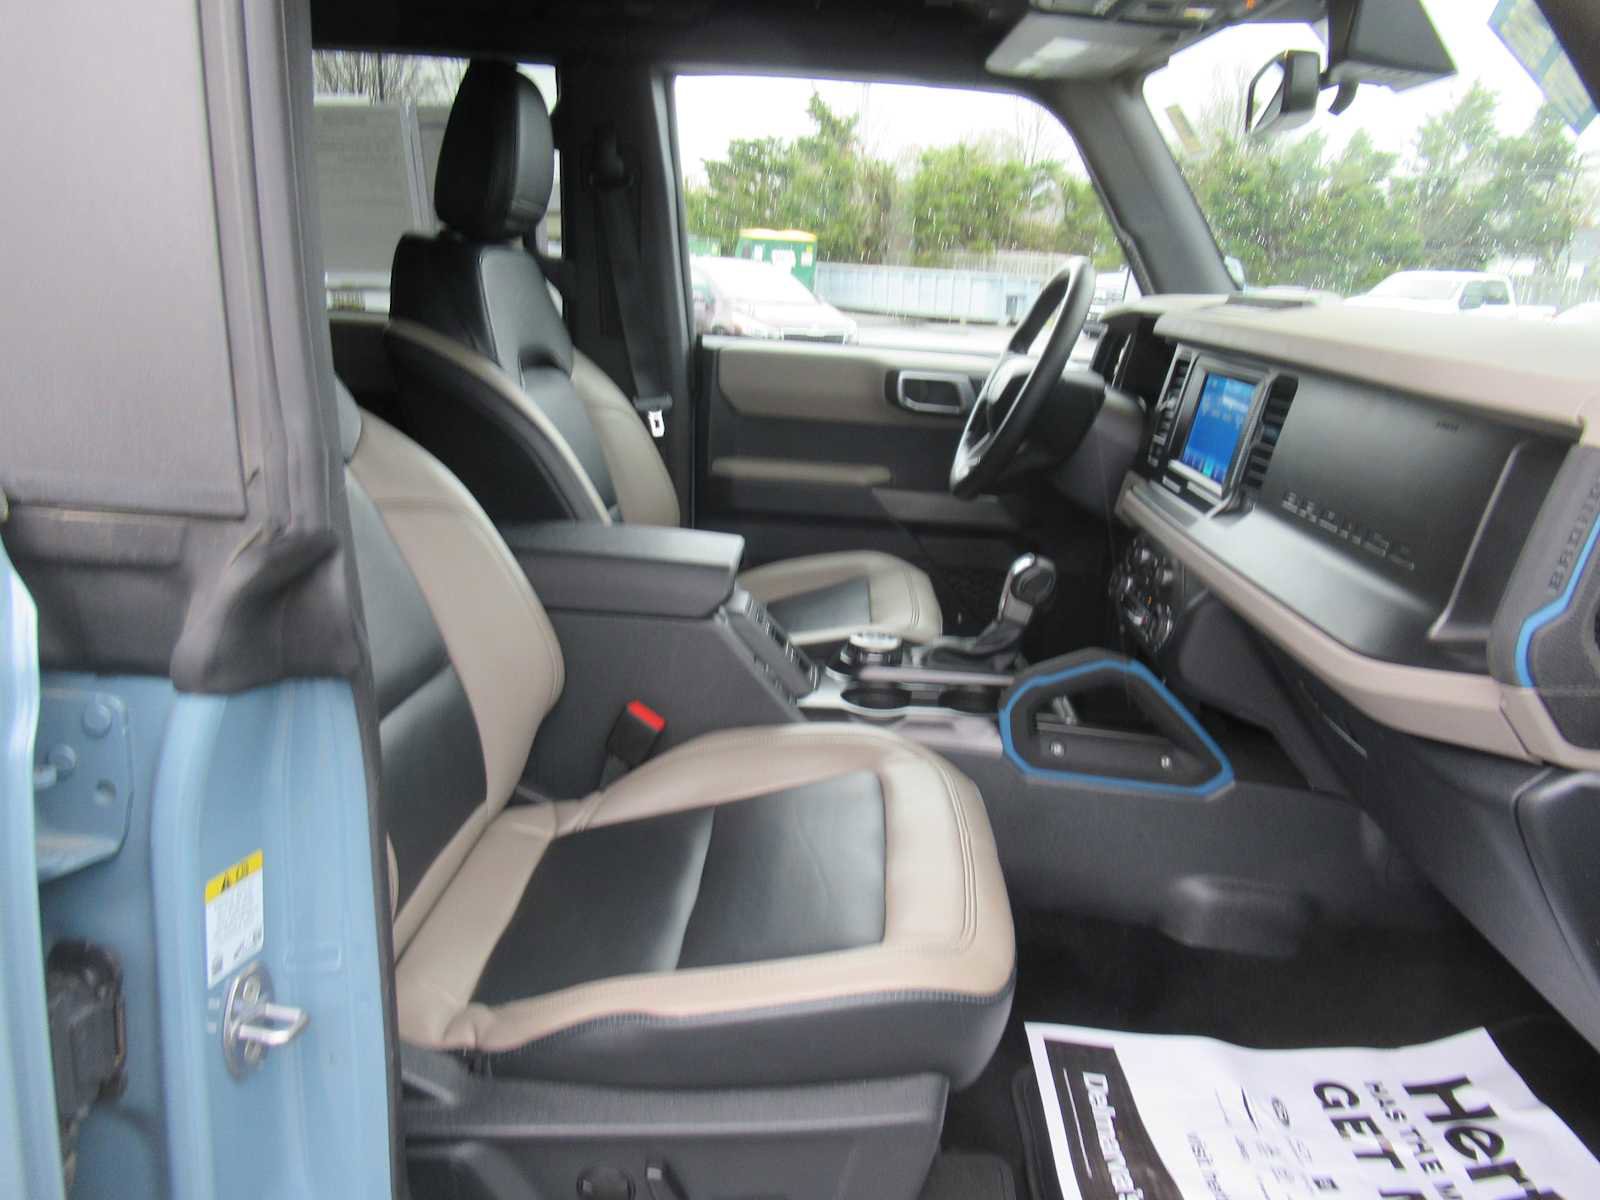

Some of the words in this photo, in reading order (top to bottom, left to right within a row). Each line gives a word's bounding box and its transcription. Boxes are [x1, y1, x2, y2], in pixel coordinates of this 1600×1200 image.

[1312, 1081, 1406, 1171] GET
[1364, 1080, 1407, 1121] HAS
[1401, 1124, 1444, 1174] THE
